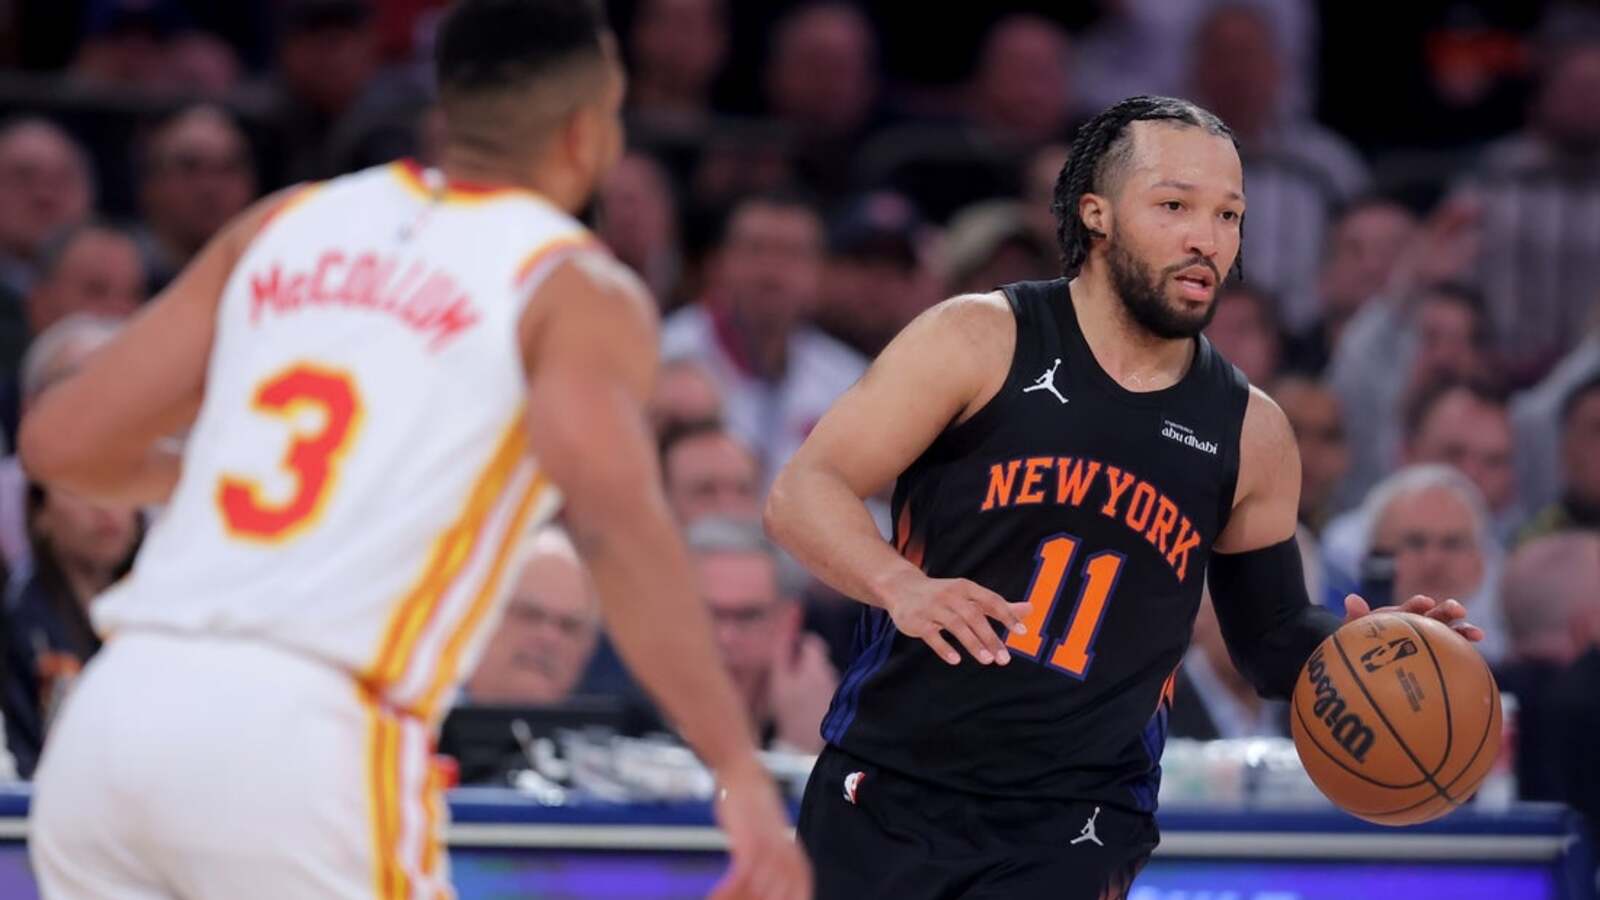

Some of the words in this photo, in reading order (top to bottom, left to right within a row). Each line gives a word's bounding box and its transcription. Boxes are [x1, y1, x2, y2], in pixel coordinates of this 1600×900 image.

[215, 361, 364, 542] 3
[1161, 427, 1183, 442] abu
[1184, 434, 1218, 454] dhabi
[980, 456, 1101, 512] NEW
[1101, 465, 1200, 582] YORK
[1004, 532, 1127, 681] 11
[1307, 647, 1375, 764] Wilson
